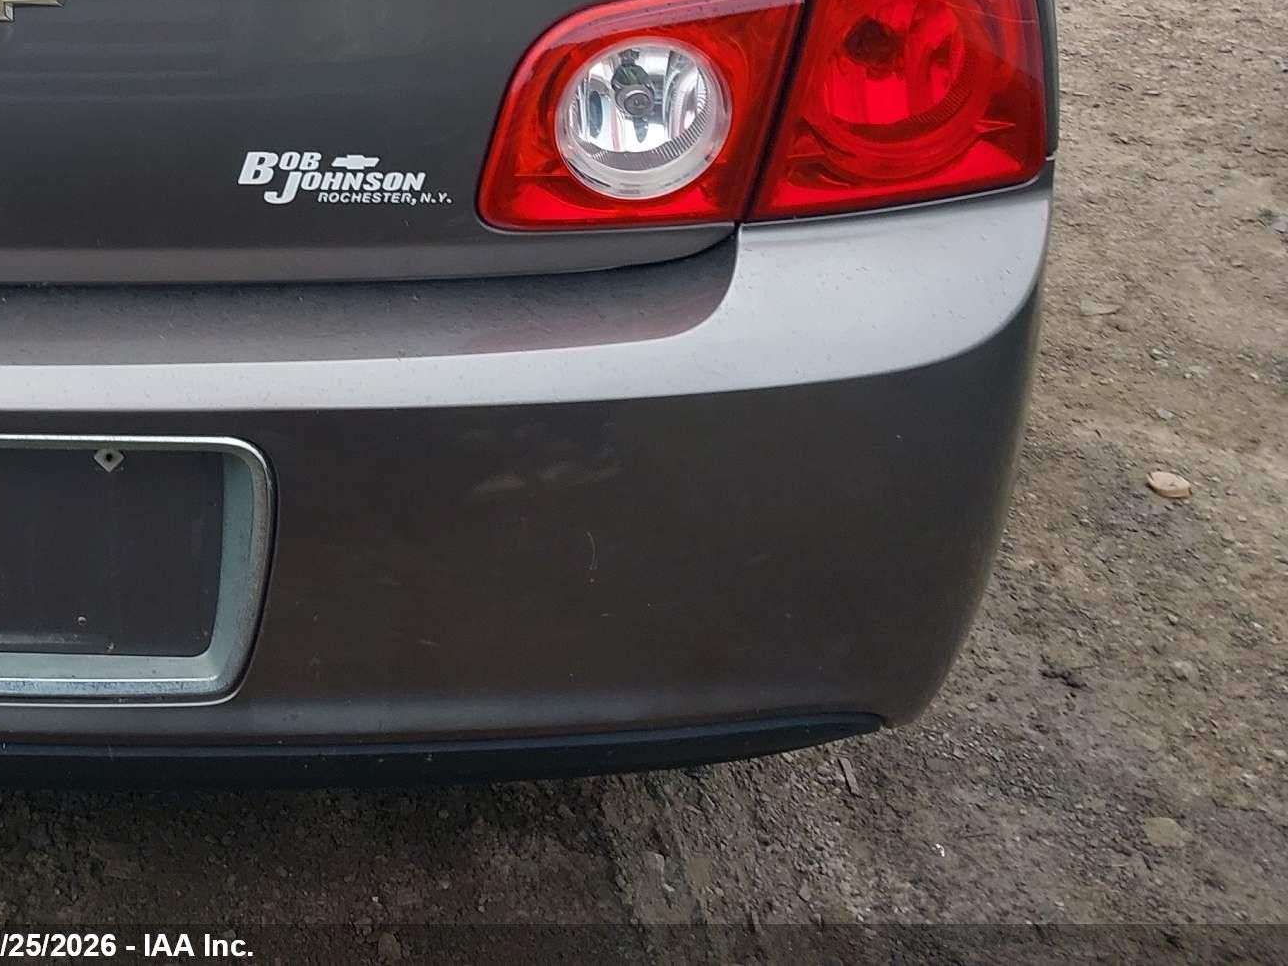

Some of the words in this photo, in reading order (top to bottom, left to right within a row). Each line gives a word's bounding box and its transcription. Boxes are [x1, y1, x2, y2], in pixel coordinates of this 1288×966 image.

[238, 151, 322, 185] BOB
[264, 171, 426, 204] JOHNSON
[317, 192, 417, 205] ROCHESTER,
[420, 192, 452, 204] N.Y.
